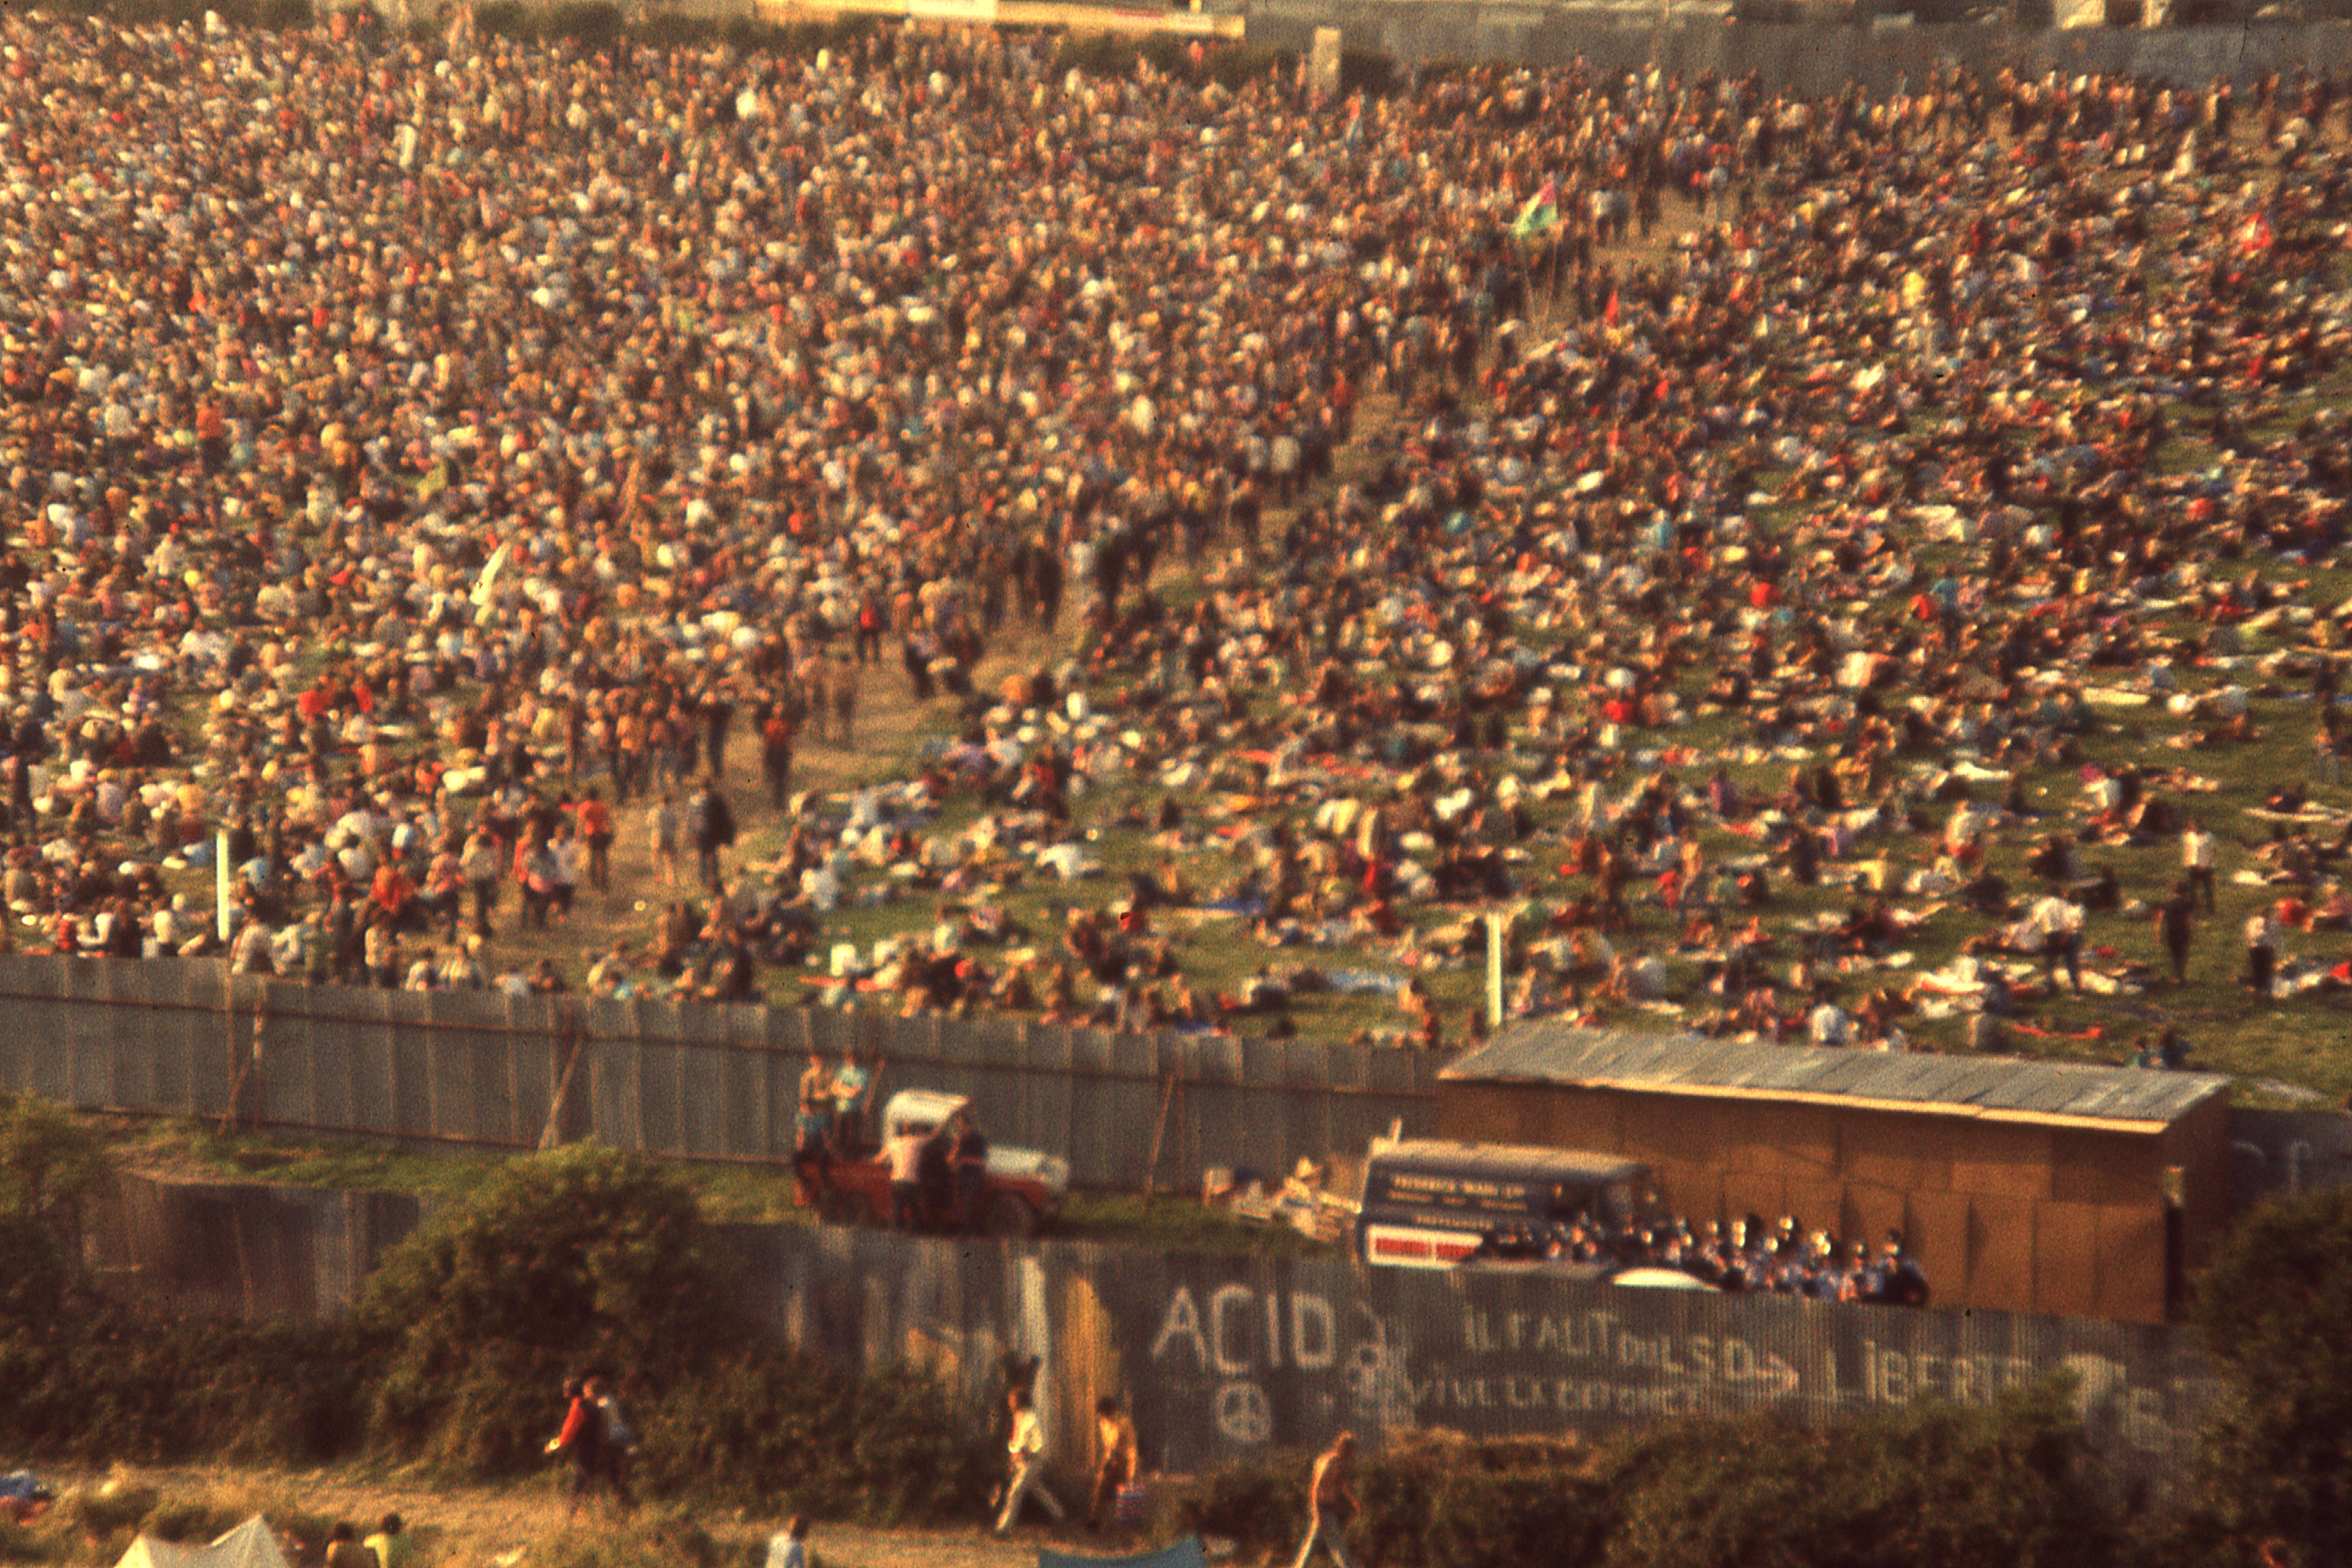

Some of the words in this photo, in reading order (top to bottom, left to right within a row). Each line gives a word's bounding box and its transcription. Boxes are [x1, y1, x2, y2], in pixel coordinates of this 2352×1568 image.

[1151, 1285, 1337, 1375] ACID
[1463, 1307, 1498, 1351] IL
[1506, 1309, 1620, 1356] FAUT
